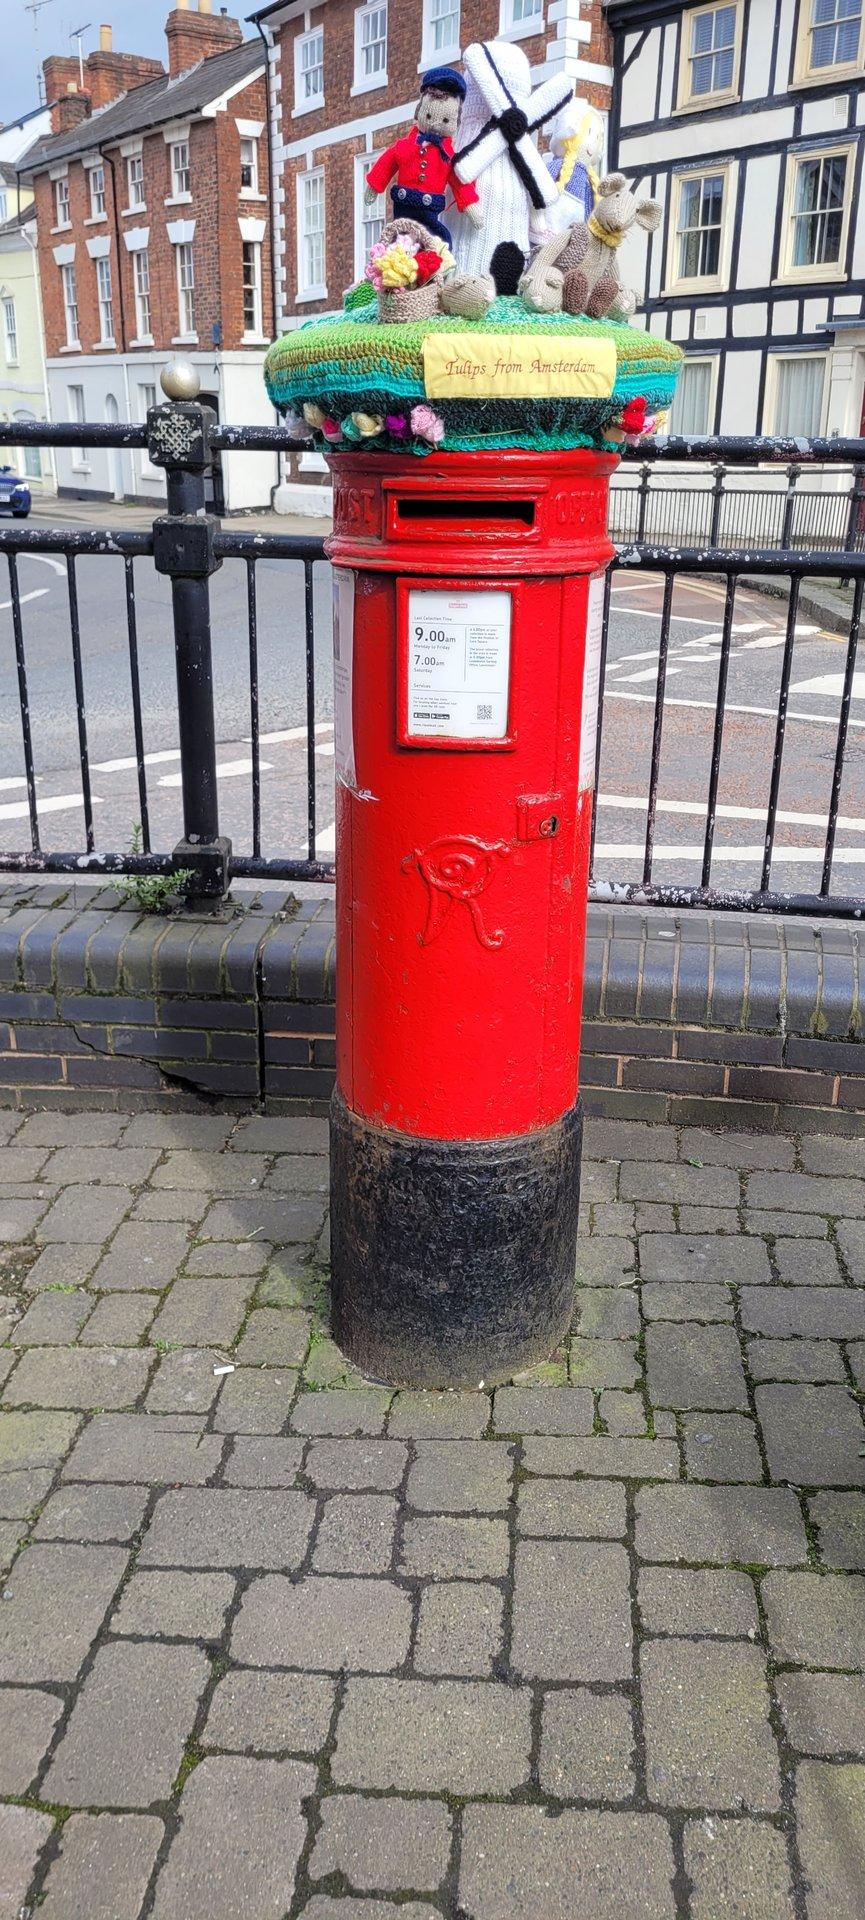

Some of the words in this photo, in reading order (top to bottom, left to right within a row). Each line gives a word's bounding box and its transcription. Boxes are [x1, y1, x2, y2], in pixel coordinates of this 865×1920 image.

[445, 356, 487, 380] Tulips
[491, 358, 523, 378] from
[529, 358, 596, 374] Amsterdam
